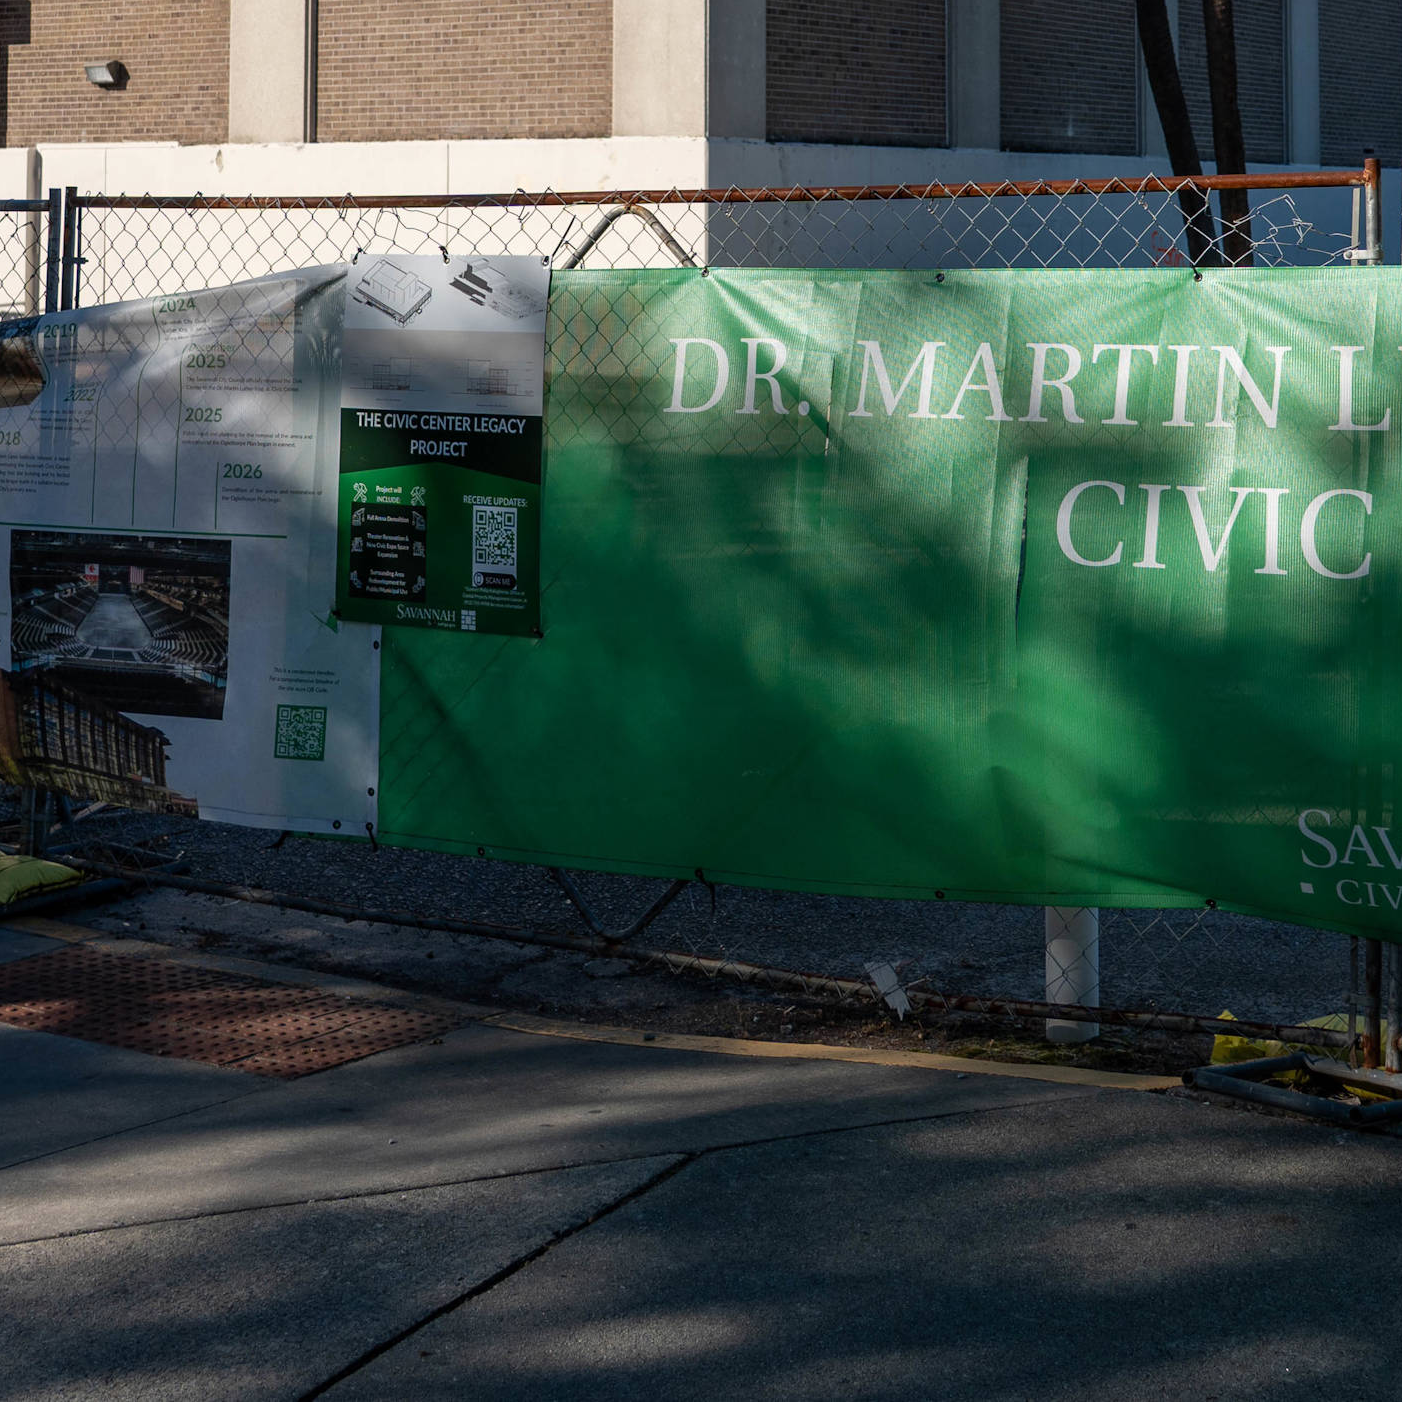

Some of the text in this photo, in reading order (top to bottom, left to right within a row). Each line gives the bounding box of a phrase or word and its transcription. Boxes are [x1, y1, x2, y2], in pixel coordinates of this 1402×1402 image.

[158, 297, 196, 314] 2024
[44, 322, 78, 338] 2019
[186, 354, 226, 369] 2025
[664, 337, 811, 417] DR.
[848, 339, 1293, 429] MARTIN
[63, 388, 96, 402] 2022
[185, 407, 222, 422] 2025
[356, 412, 526, 434] THE CIVIC CENTER LEGACY
[410, 439, 468, 457] PROJECT
[223, 463, 263, 479] 2026
[462, 495, 528, 507] RECEIVE UPDATES:
[1055, 480, 1373, 581] CIVIC
[485, 577, 500, 585] SCAN
[396, 603, 456, 622] SAVANNAH
